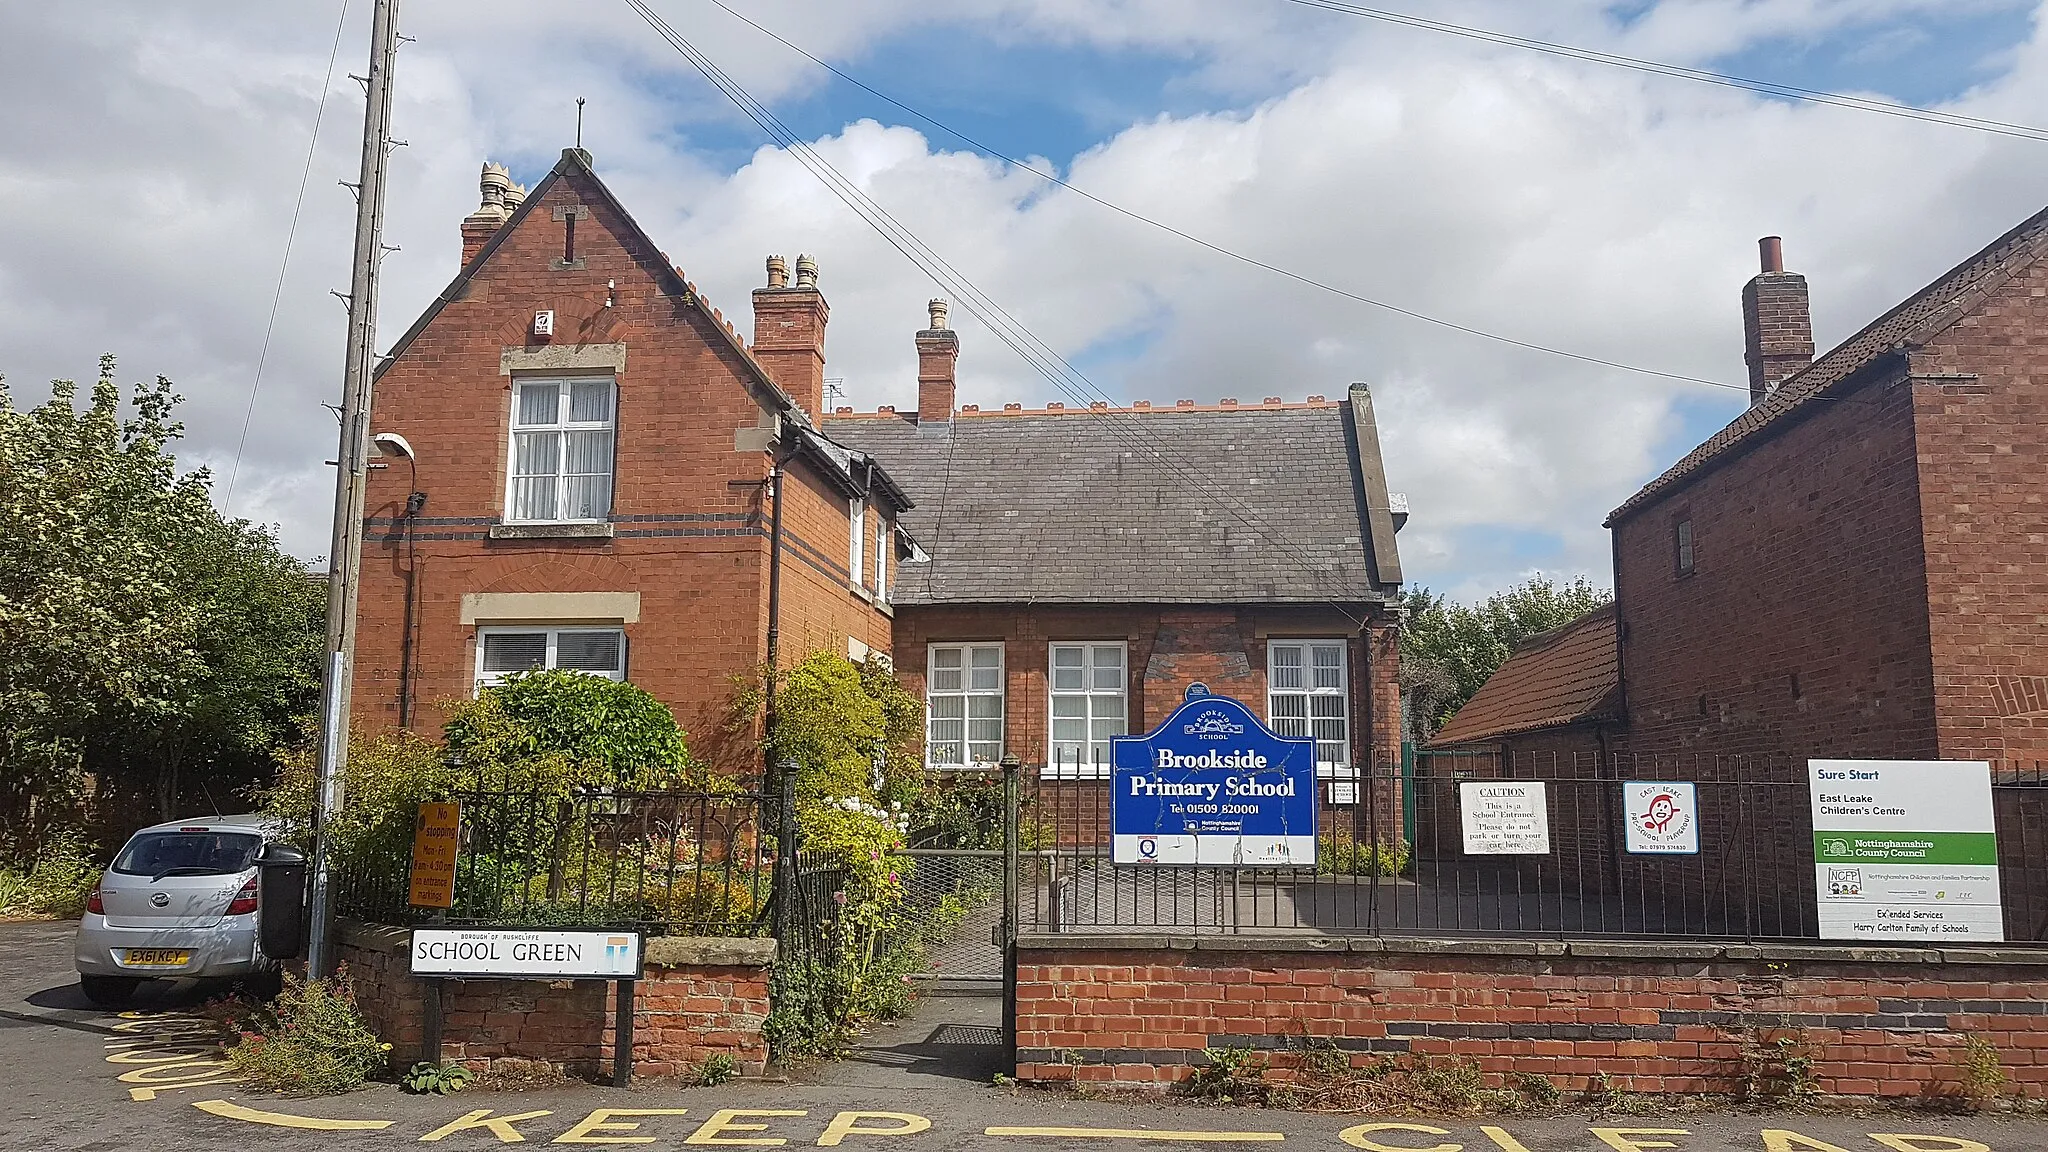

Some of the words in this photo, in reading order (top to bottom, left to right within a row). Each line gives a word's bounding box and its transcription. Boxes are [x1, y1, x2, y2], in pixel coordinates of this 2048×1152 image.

[1194, 710, 1231, 728] BROOKSIDE
[1157, 749, 1267, 769] Brookside
[1818, 769, 1845, 780] Sure
[1849, 769, 1879, 780] Start
[1130, 776, 1220, 801] Primary
[1225, 776, 1295, 797] School
[1480, 788, 1525, 796] CAUTION
[1640, 787, 1656, 798] EAST
[1663, 786, 1682, 798] LEAKE
[1819, 794, 1841, 803] East
[1844, 794, 1873, 803] Leake
[438, 807, 448, 820] No
[1187, 804, 1217, 814] 01509
[1222, 804, 1259, 814] 820001
[1820, 806, 1870, 815] Children's
[1873, 807, 1906, 816] Centre
[426, 824, 456, 840] stopping
[1631, 813, 1659, 842] PRE-SCHOOL
[1666, 813, 1691, 842] PLAYGROUP
[1855, 839, 1934, 849] Nottinghamshire
[1855, 849, 1888, 858] County
[1890, 849, 1926, 857] Council
[415, 877, 422, 885] on
[423, 877, 447, 887] entrance
[1868, 873, 1909, 881] Nottinghamshire
[1961, 874, 1990, 882] Partnership
[417, 890, 442, 902] markings
[1913, 910, 1943, 919] Services
[1853, 922, 1874, 933] Harry
[1877, 923, 1903, 932] Carlton
[1906, 923, 1929, 934] Family
[1931, 923, 1939, 932] of
[1942, 924, 1969, 933] Schools
[131, 951, 156, 962] EX61
[158, 951, 181, 962] KCY
[417, 942, 500, 960] SCHOOL
[513, 943, 582, 962] GREEN
[417, 1108, 932, 1147] KEEP
